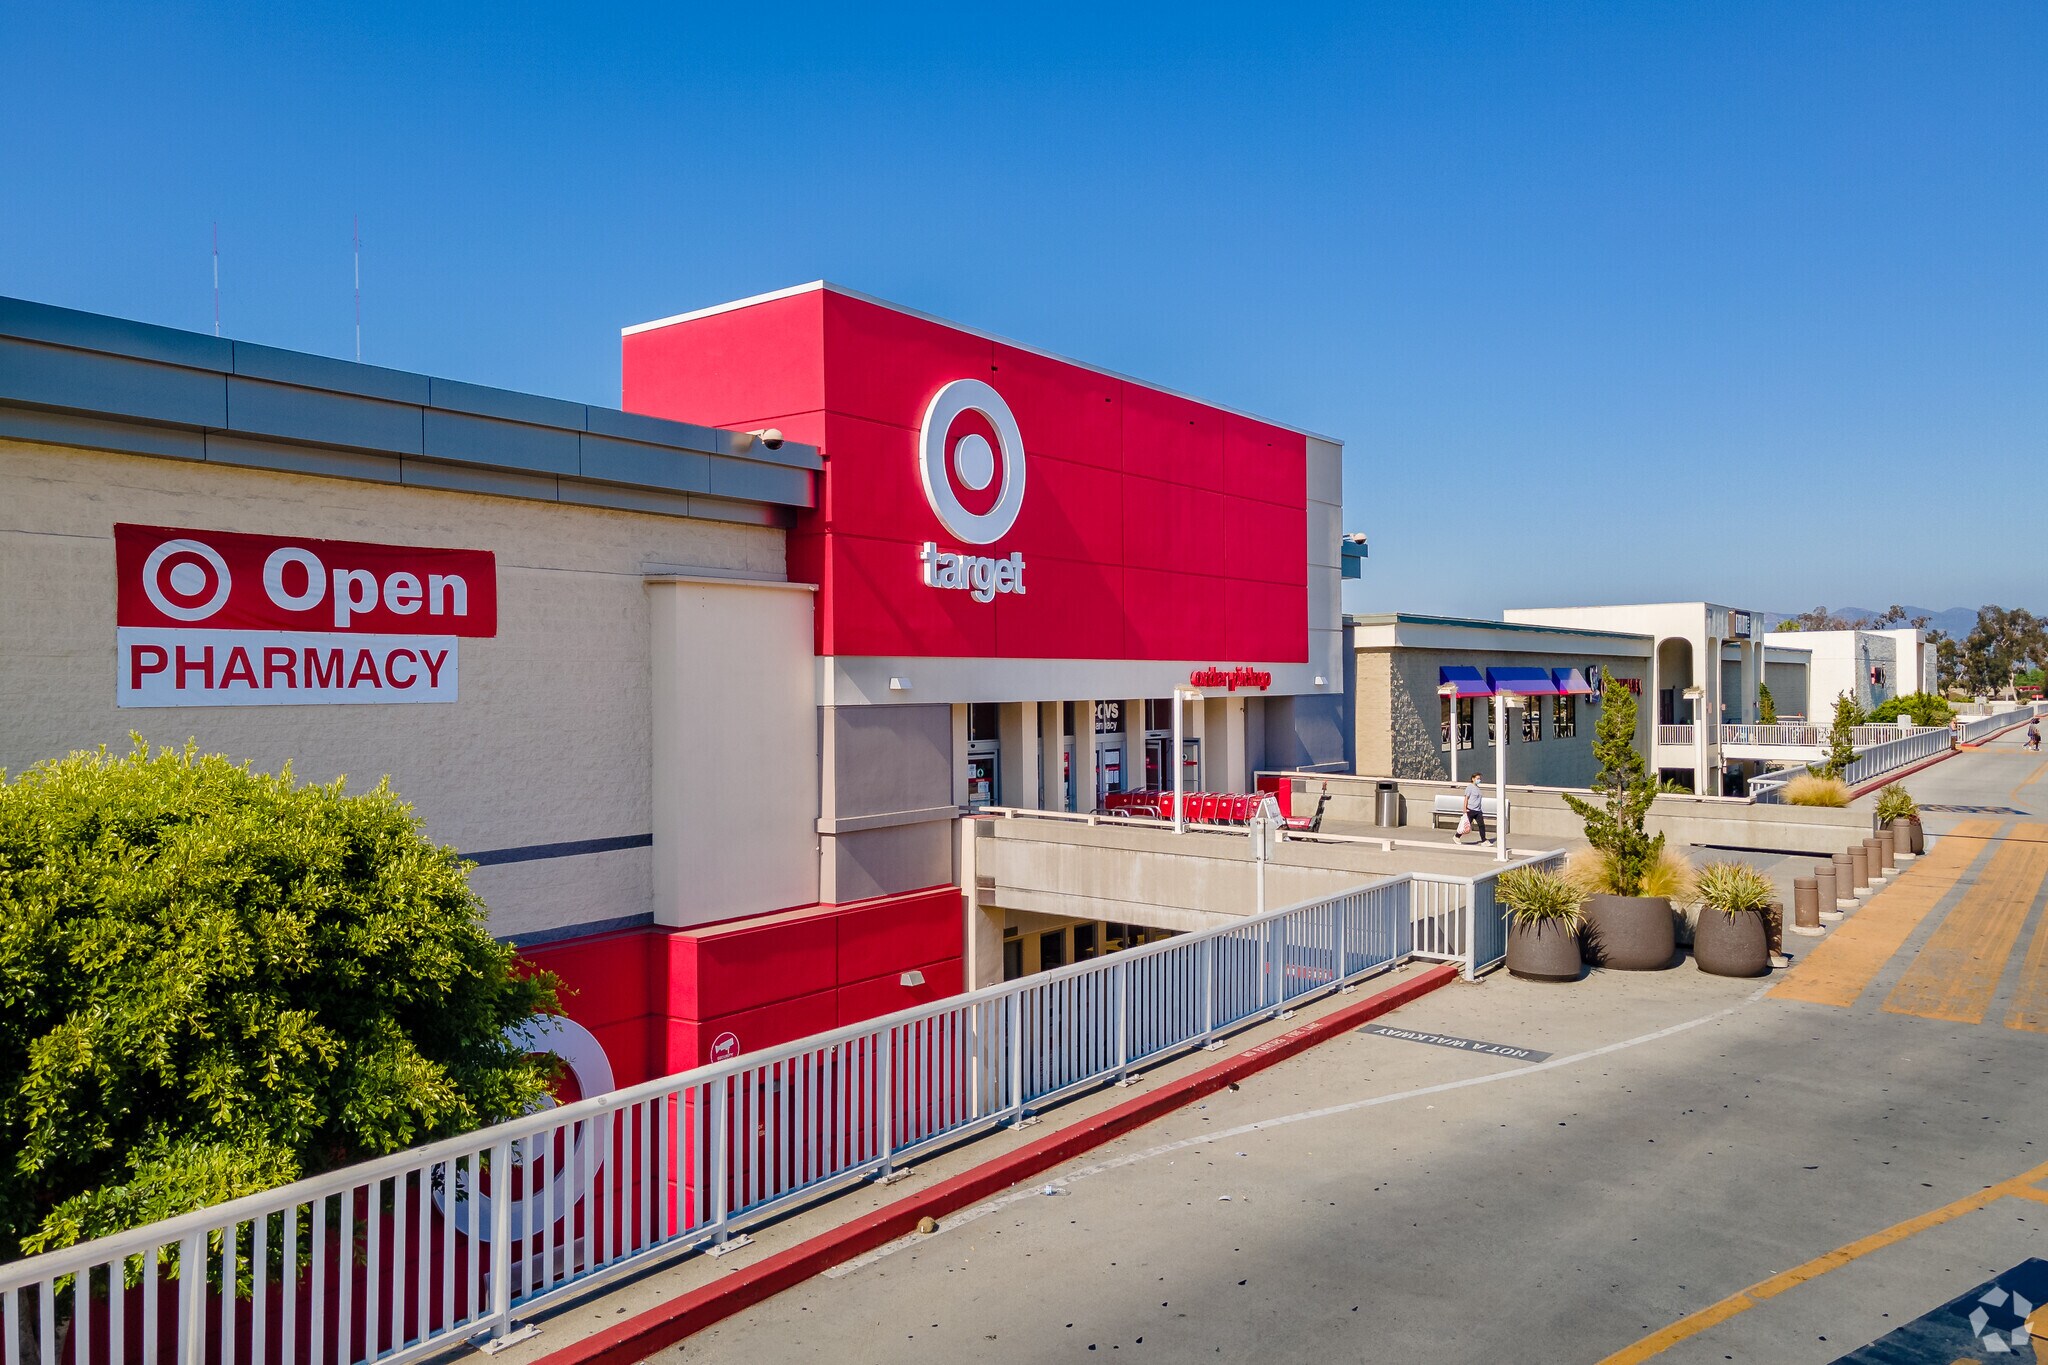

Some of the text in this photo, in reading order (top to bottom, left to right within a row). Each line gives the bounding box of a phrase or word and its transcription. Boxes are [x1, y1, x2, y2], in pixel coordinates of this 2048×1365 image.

[263, 546, 468, 628] Open
[920, 541, 1026, 603] target
[130, 644, 449, 691] PHARMACY
[1097, 703, 1119, 719] CVS
[1373, 1027, 1529, 1058] NOT A WALKWAY
